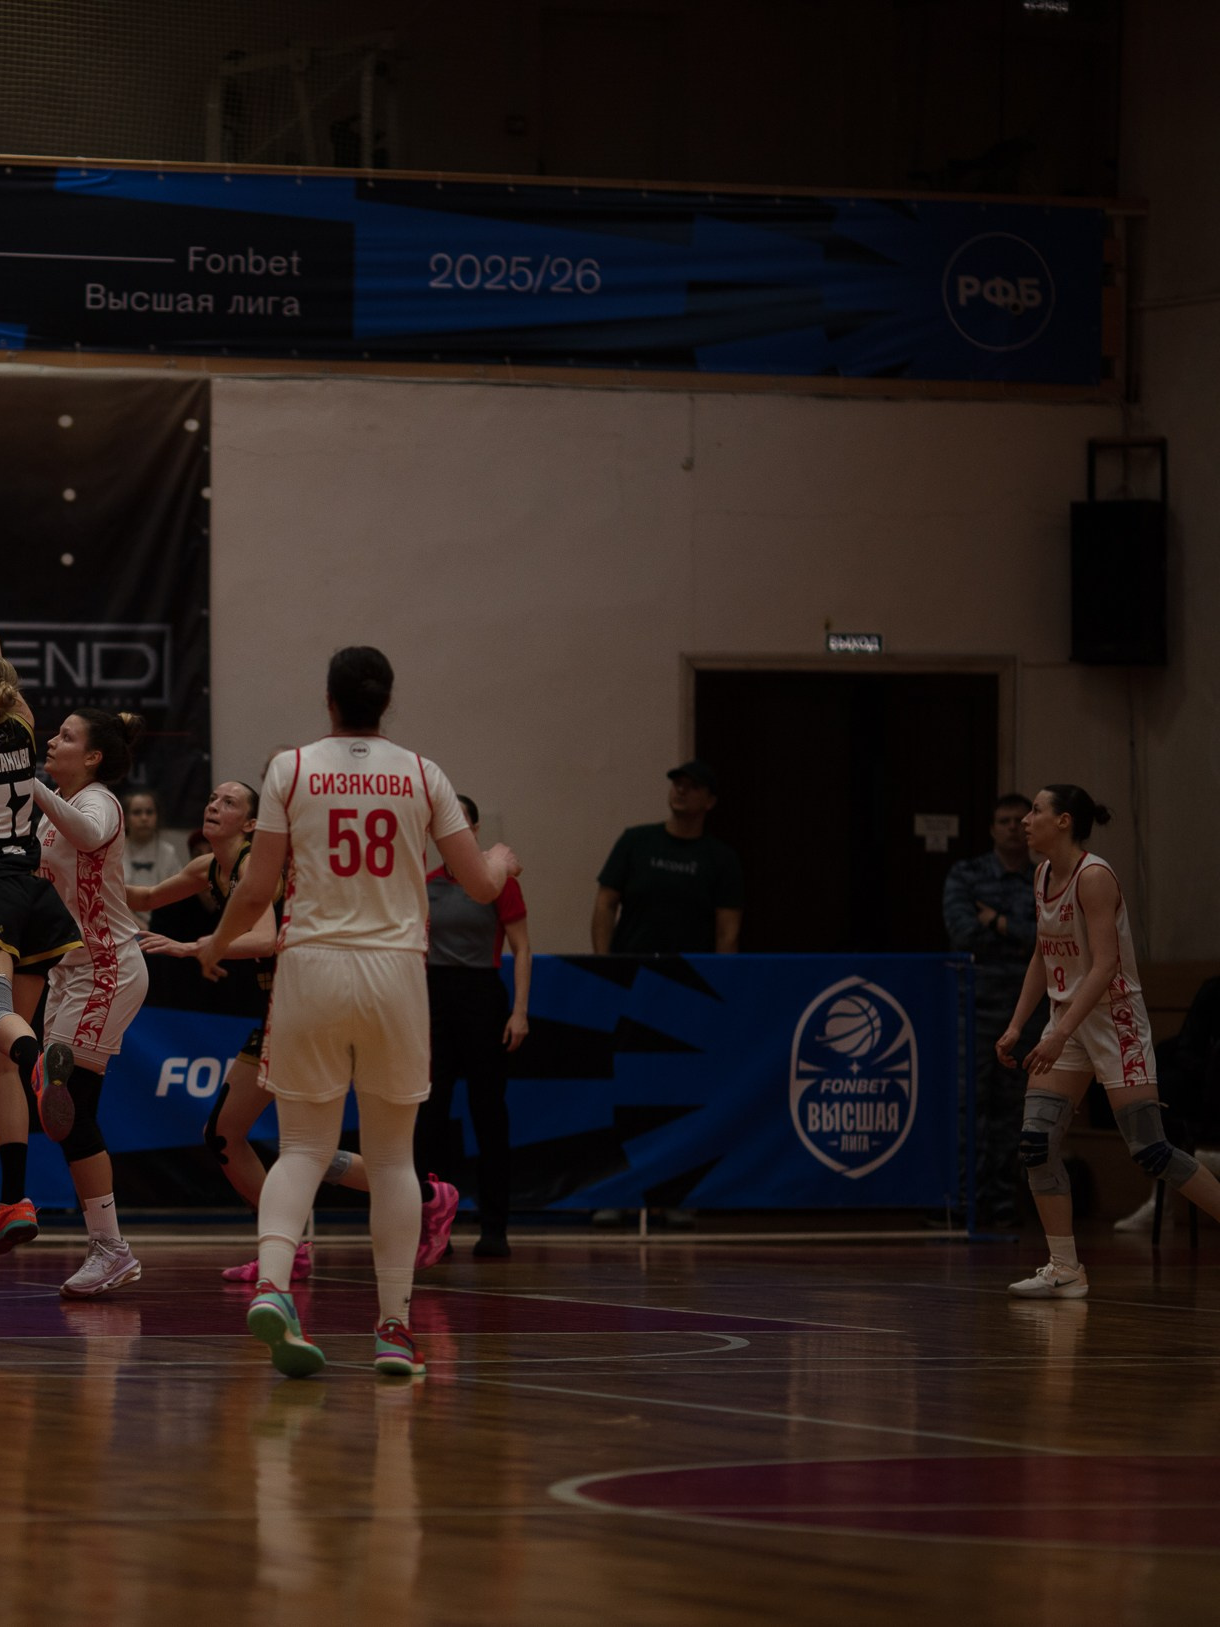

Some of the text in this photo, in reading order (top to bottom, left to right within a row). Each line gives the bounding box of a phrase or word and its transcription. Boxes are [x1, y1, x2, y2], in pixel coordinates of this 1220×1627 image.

[188, 247, 302, 277] Fonbet
[428, 252, 602, 295] 2025/26
[84, 283, 302, 318] Высшая лига
[957, 273, 1042, 310] РФБ
[309, 772, 414, 797] СИЗЯКОВА
[329, 809, 397, 877] 58
[1041, 941, 1080, 957] НОСТЬ
[1053, 966, 1065, 992] 9
[820, 1078, 890, 1096] FONBET
[807, 1100, 899, 1134] ВЫСШАЯ
[840, 1134, 871, 1153] ЛИГА
